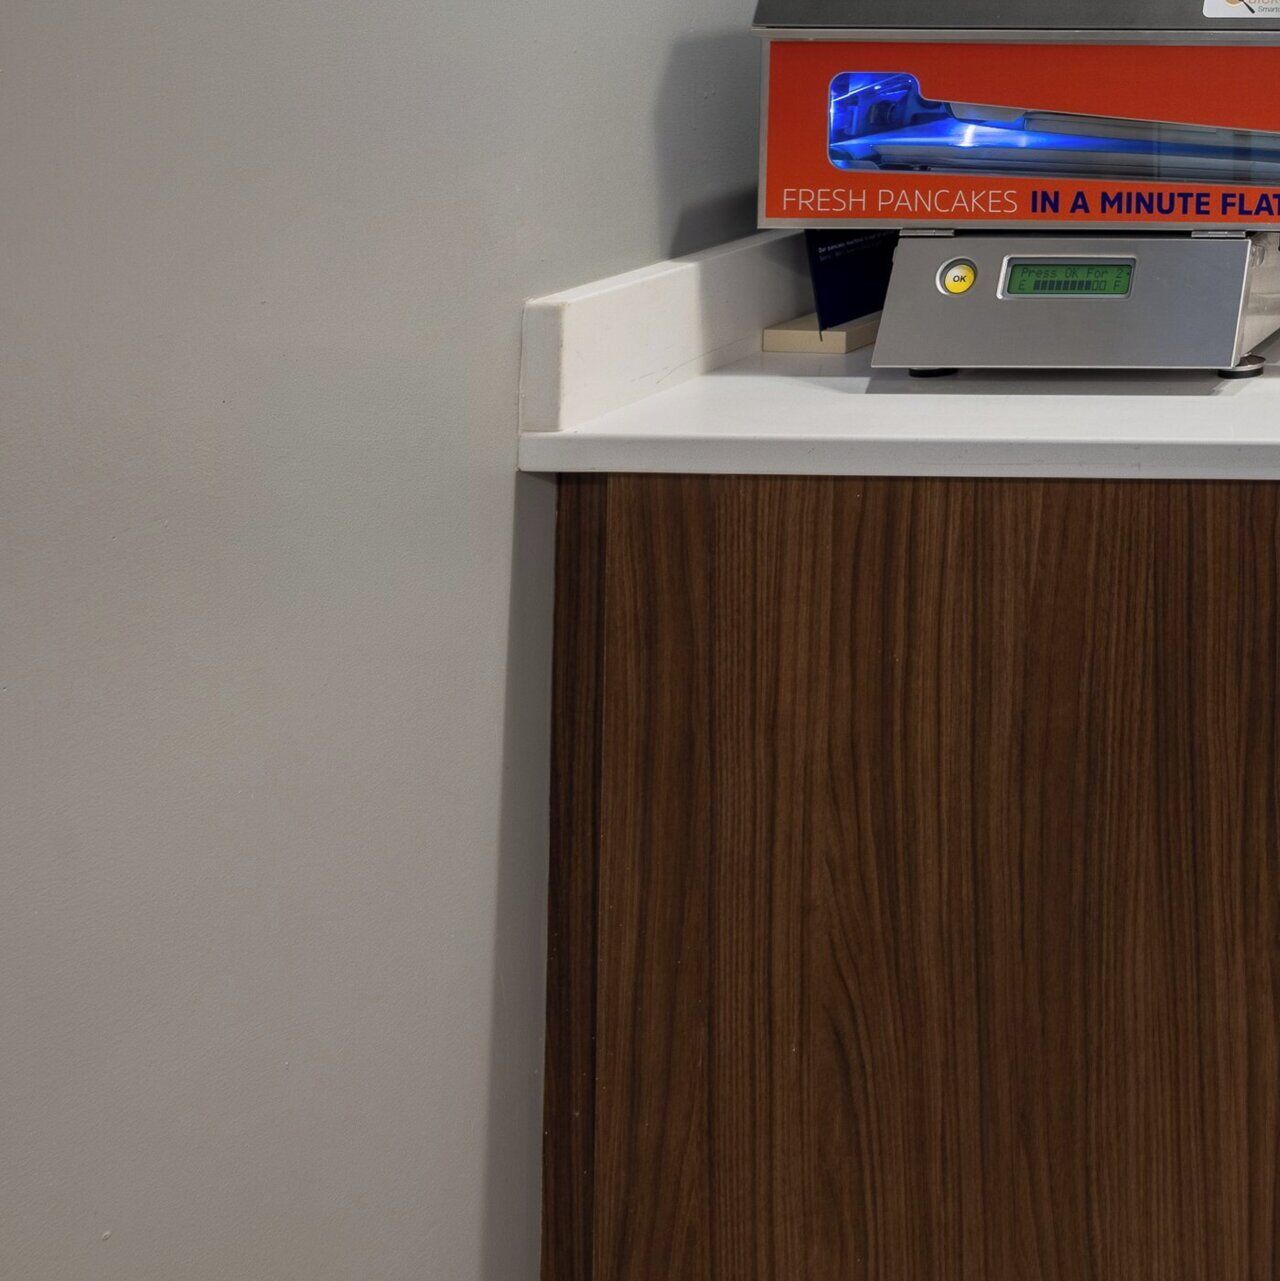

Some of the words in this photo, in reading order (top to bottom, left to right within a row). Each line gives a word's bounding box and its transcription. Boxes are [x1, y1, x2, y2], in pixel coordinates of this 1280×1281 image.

[784, 189, 865, 211] FRESH
[878, 189, 1018, 214] PANCAKES
[1032, 191, 1059, 213] IN
[1070, 191, 1089, 213] A
[1100, 191, 1209, 216] MINUTE
[1021, 268, 1057, 278] Press
[1065, 268, 1079, 278] OK
[1086, 268, 1107, 278] For
[952, 275, 967, 283] OK
